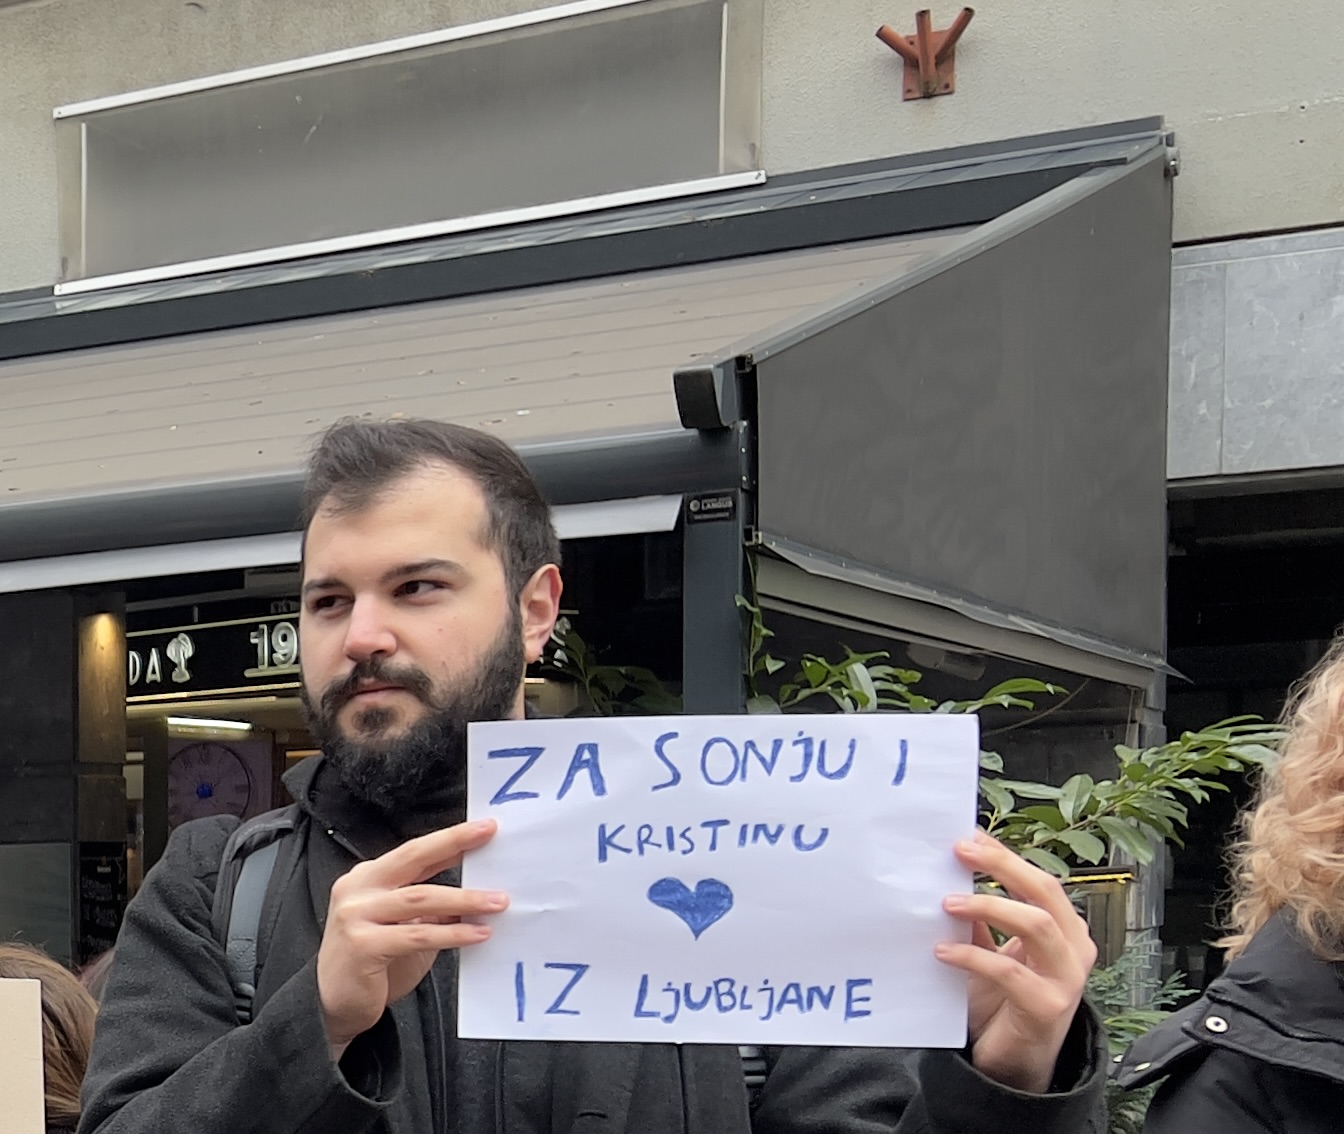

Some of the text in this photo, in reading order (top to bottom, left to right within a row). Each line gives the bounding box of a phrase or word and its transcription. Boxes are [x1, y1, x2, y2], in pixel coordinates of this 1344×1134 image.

[487, 741, 608, 806] ZA
[891, 738, 909, 787] I
[596, 818, 830, 864] KRISTINU
[514, 960, 591, 1023] IZ
